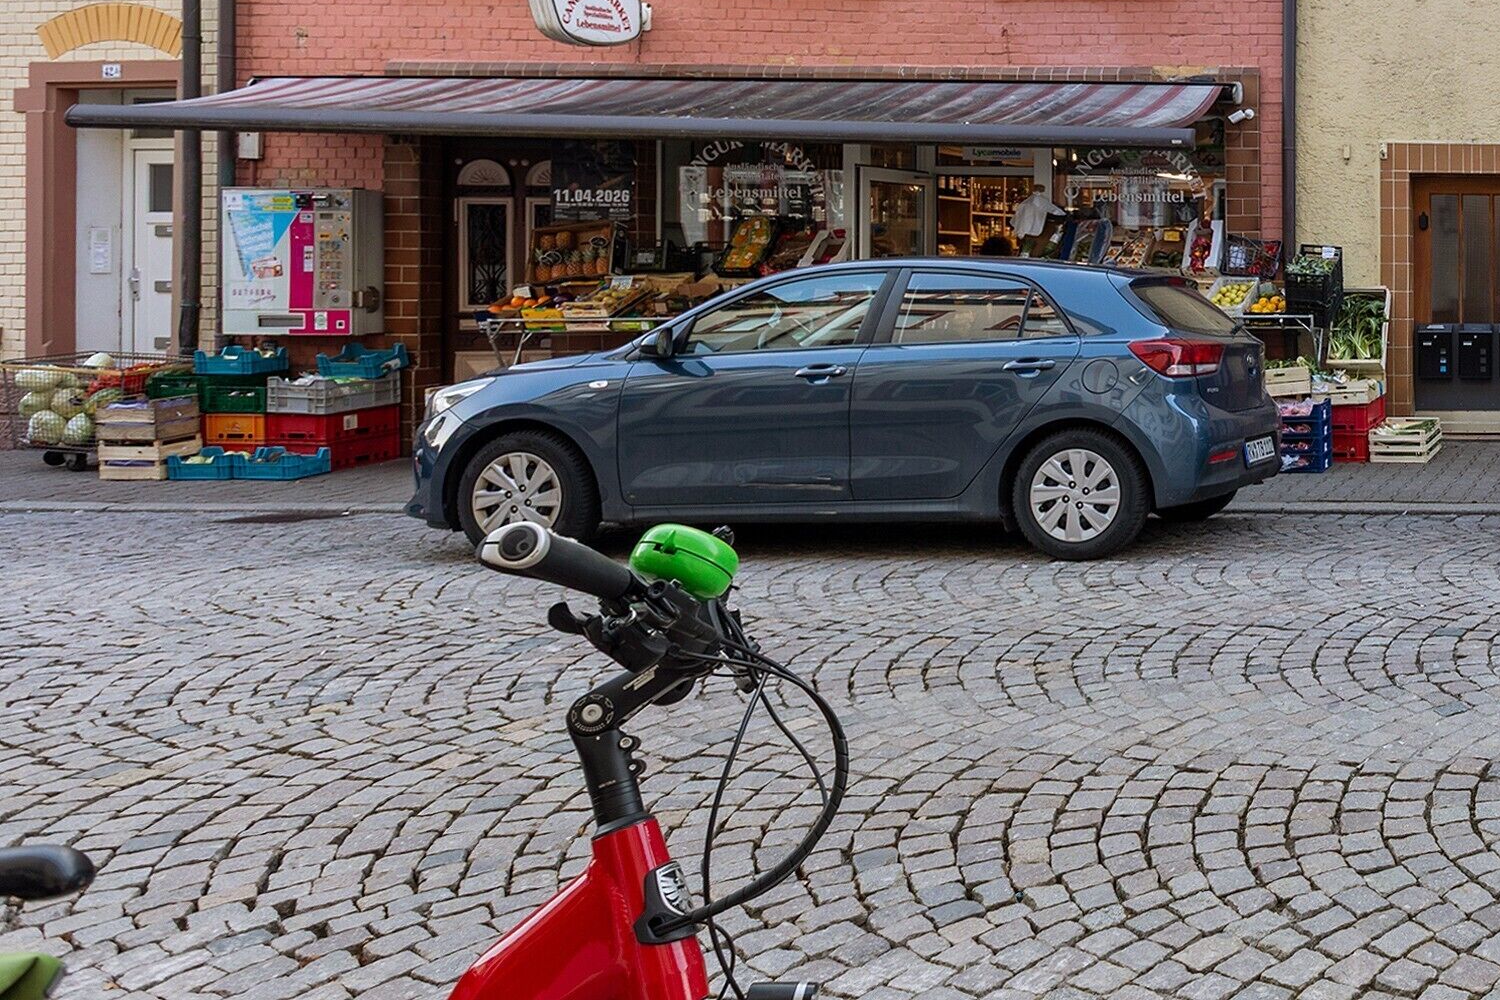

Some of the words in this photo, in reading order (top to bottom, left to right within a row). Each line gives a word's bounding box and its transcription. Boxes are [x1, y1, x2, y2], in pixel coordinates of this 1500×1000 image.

[576, 19, 621, 33] Lebensmittel
[553, 189, 630, 203] 11.04.2026
[708, 186, 802, 200] Lebensmittel
[1092, 190, 1185, 203] Lebensmittel
